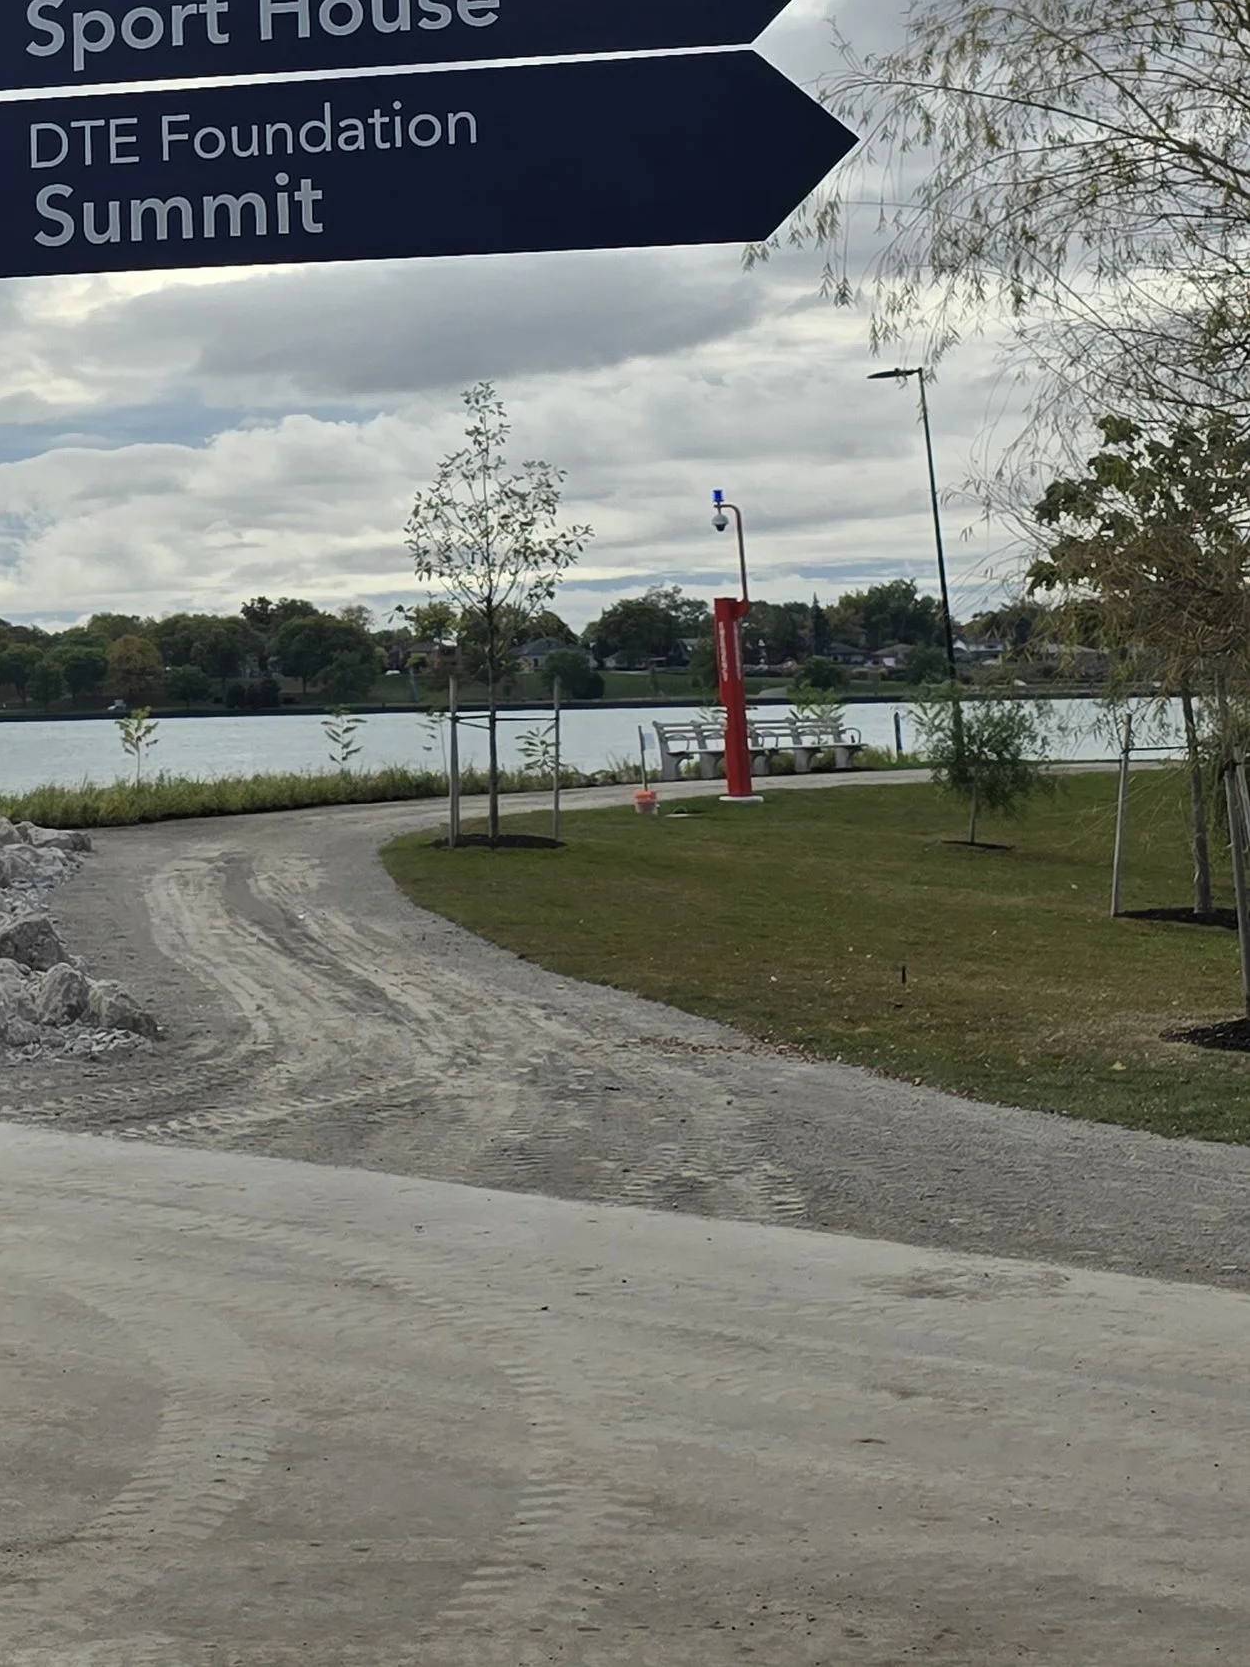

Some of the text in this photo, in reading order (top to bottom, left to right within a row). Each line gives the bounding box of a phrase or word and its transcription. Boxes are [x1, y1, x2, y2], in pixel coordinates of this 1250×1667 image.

[30, 100, 478, 170] DTE Foundation
[34, 172, 324, 247] Summit
